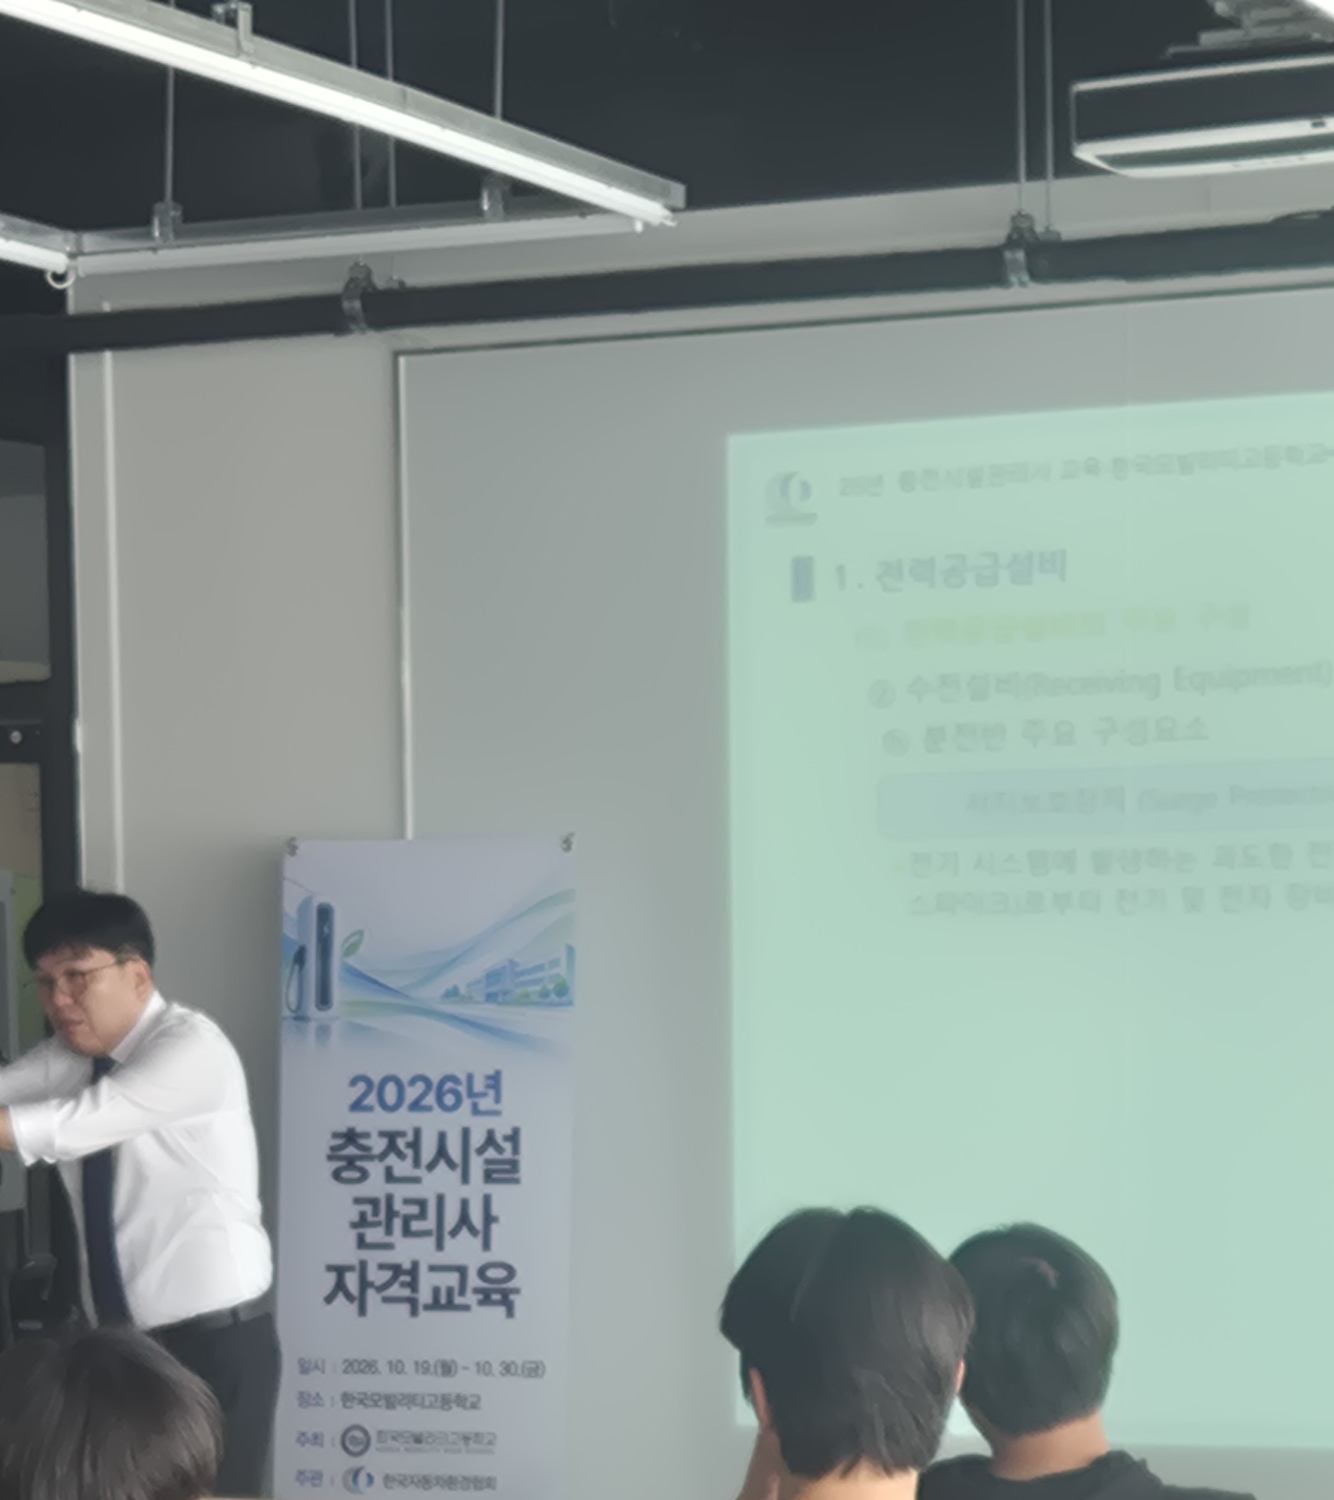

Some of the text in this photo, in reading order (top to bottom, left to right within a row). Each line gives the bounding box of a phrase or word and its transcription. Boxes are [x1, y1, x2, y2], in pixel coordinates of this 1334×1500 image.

[875, 547, 1068, 593] 전력공급설비
[1093, 715, 1211, 747] 구성요소
[347, 1068, 503, 1117] 2026년
[325, 1126, 522, 1186] 충전시설
[348, 1192, 501, 1252] 관리사
[322, 1259, 522, 1319] 자격교육
[297, 1356, 326, 1376] 일시
[386, 1358, 408, 1376] 10.
[474, 1359, 496, 1378] 10.
[339, 1390, 483, 1412] 한국모빌리티고등학교
